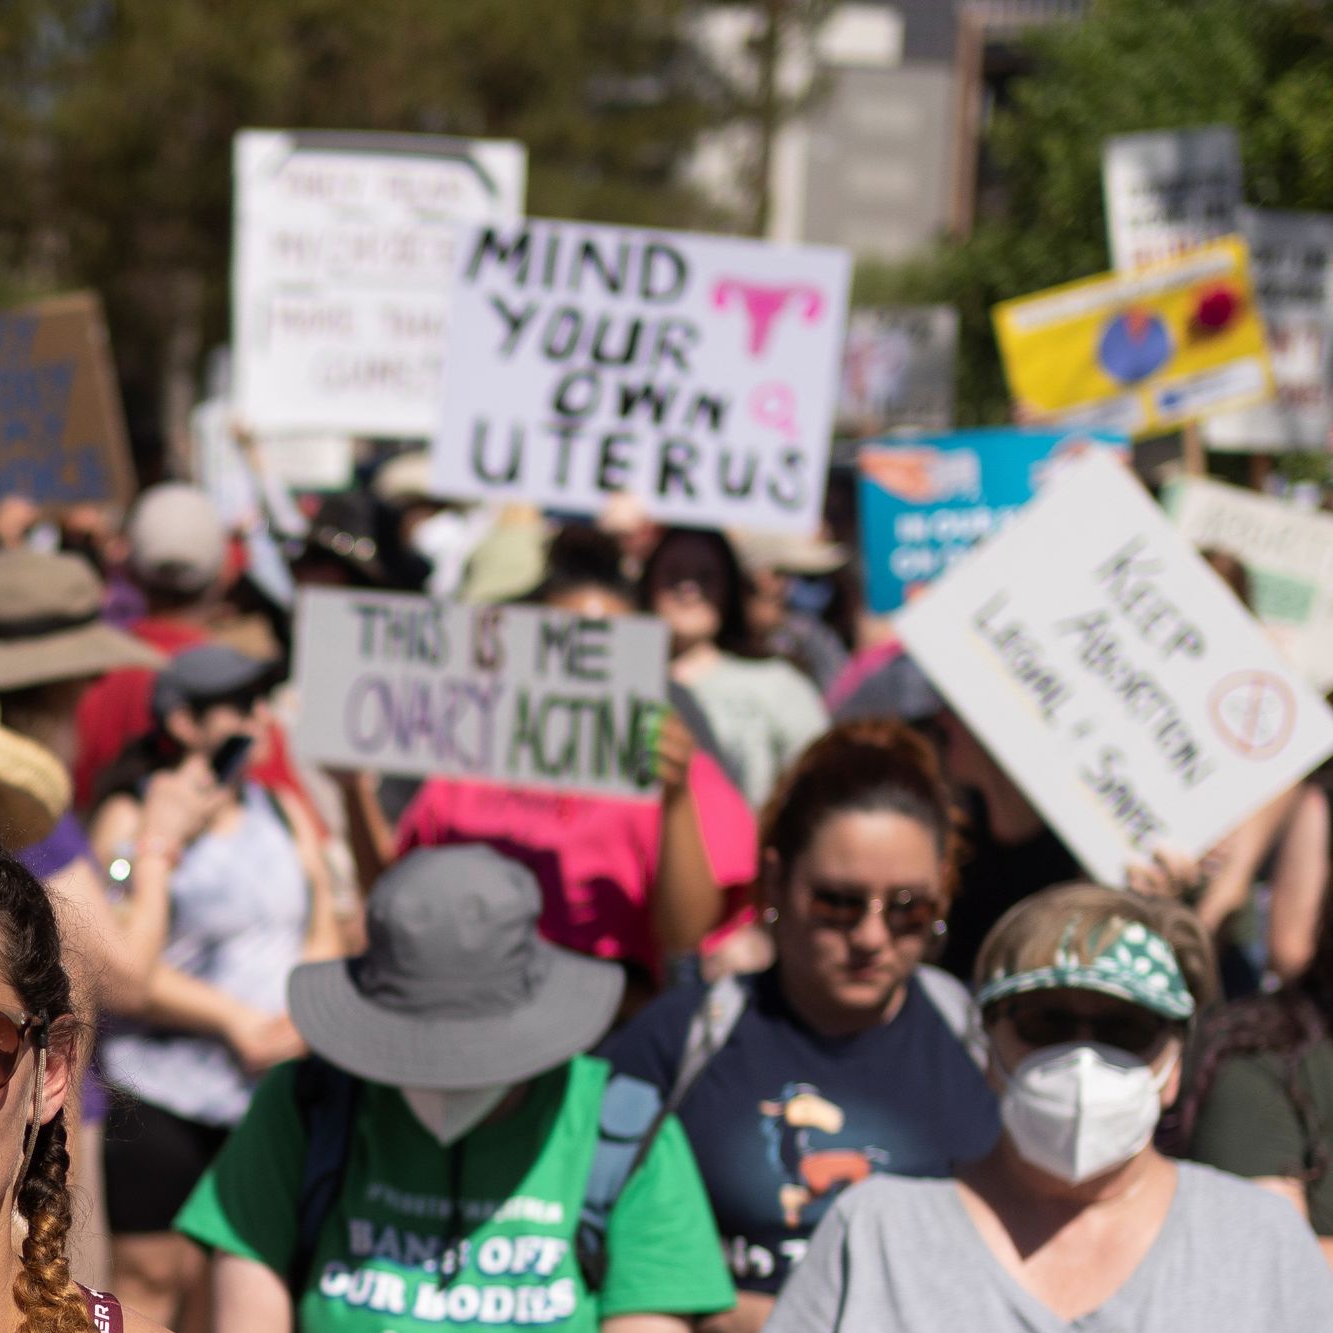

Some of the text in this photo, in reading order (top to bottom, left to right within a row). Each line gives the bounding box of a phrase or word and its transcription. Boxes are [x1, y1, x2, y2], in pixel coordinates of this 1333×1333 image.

[463, 226, 692, 305] MIND
[489, 293, 702, 372] YOUR
[550, 367, 731, 433] OWN
[469, 415, 809, 512] UTERUS
[1093, 532, 1207, 662] KEEP
[350, 602, 614, 682] THIS IS ME
[970, 588, 1071, 730] LEGAL
[1054, 608, 1219, 792] ABORTION
[320, 1261, 577, 1324] OUR BODIES
[478, 1235, 570, 1277] OFF
